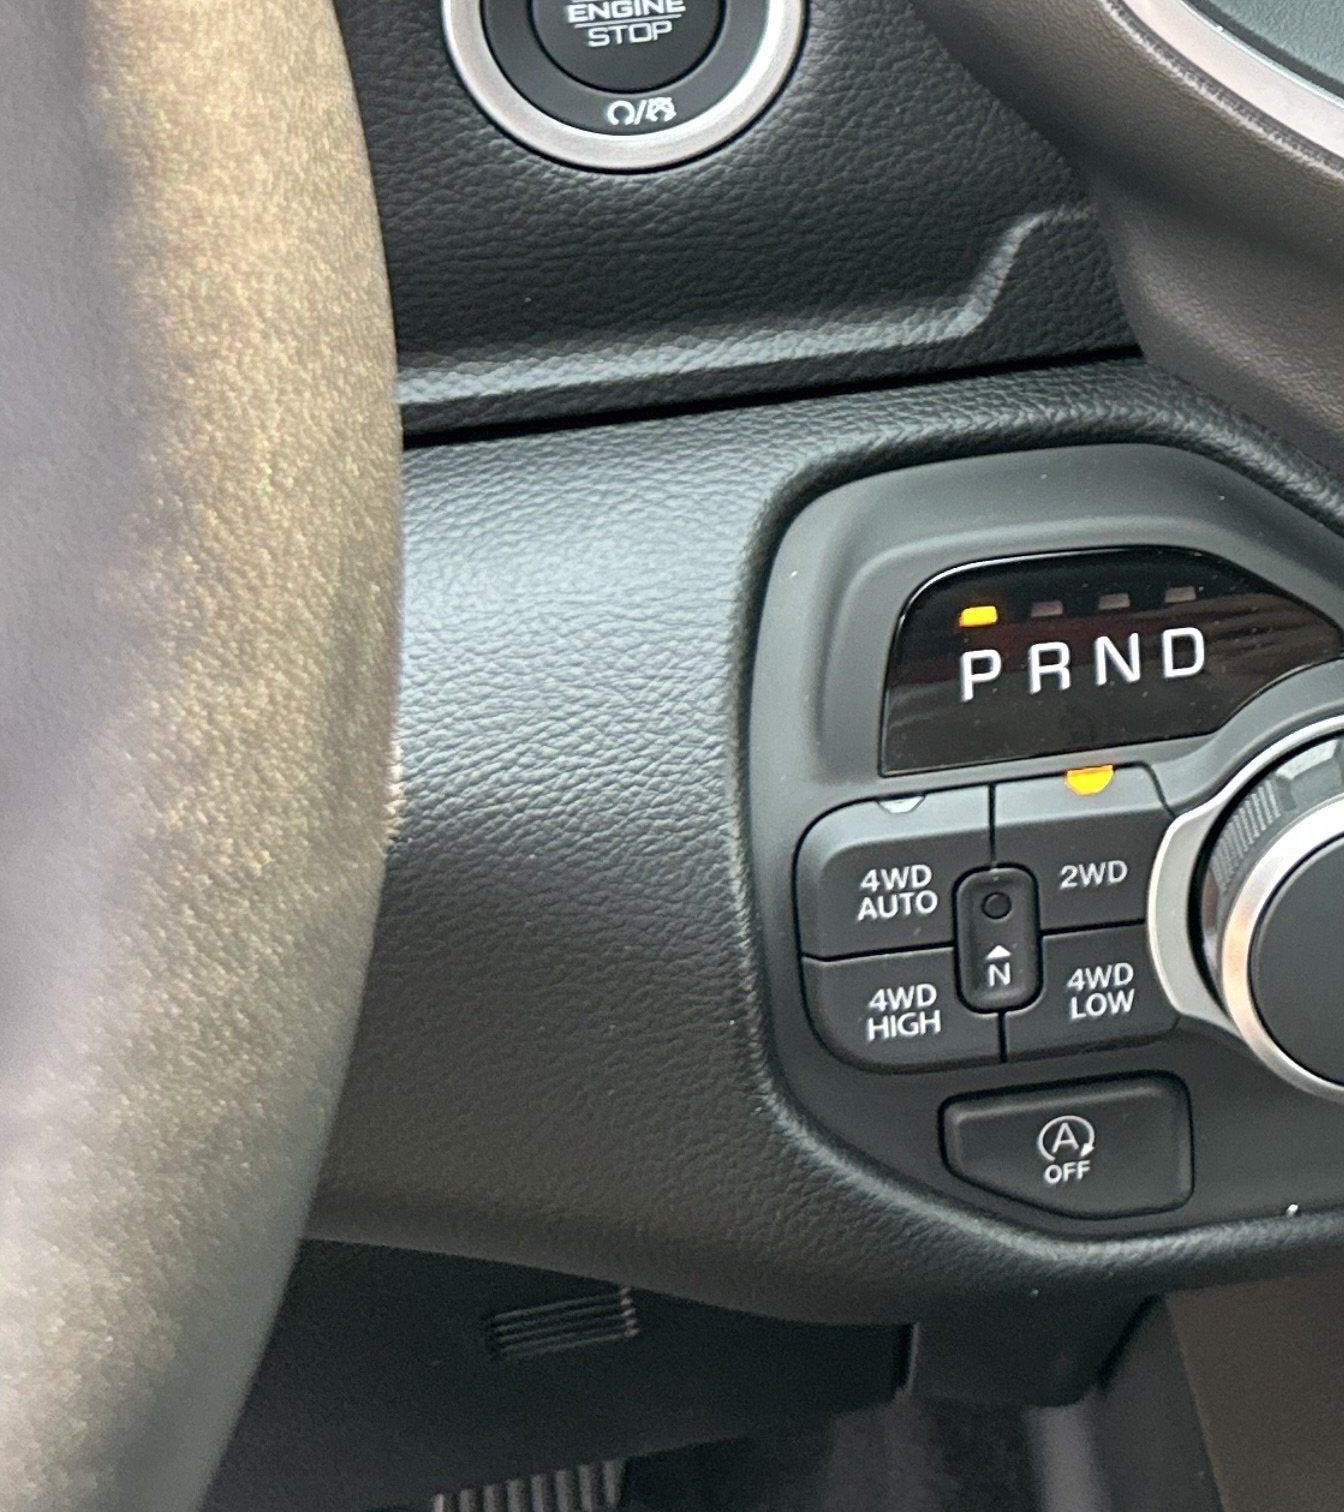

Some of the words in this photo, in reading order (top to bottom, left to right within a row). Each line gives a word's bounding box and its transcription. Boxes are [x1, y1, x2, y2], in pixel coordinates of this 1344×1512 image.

[588, 20, 672, 47] STOP
[961, 649, 1002, 701] P
[1027, 640, 1070, 695] R
[1095, 633, 1141, 687] N
[1161, 626, 1205, 679] D
[860, 864, 933, 892] 4WD
[1060, 860, 1128, 889] 2WD
[857, 890, 939, 922] AUTO
[987, 963, 1011, 988] N
[1067, 962, 1134, 992] 4WD
[868, 984, 937, 1013] 4WD
[1069, 989, 1135, 1020] LOW
[866, 1010, 942, 1042] HIGH
[1044, 1160, 1091, 1185] OFF
